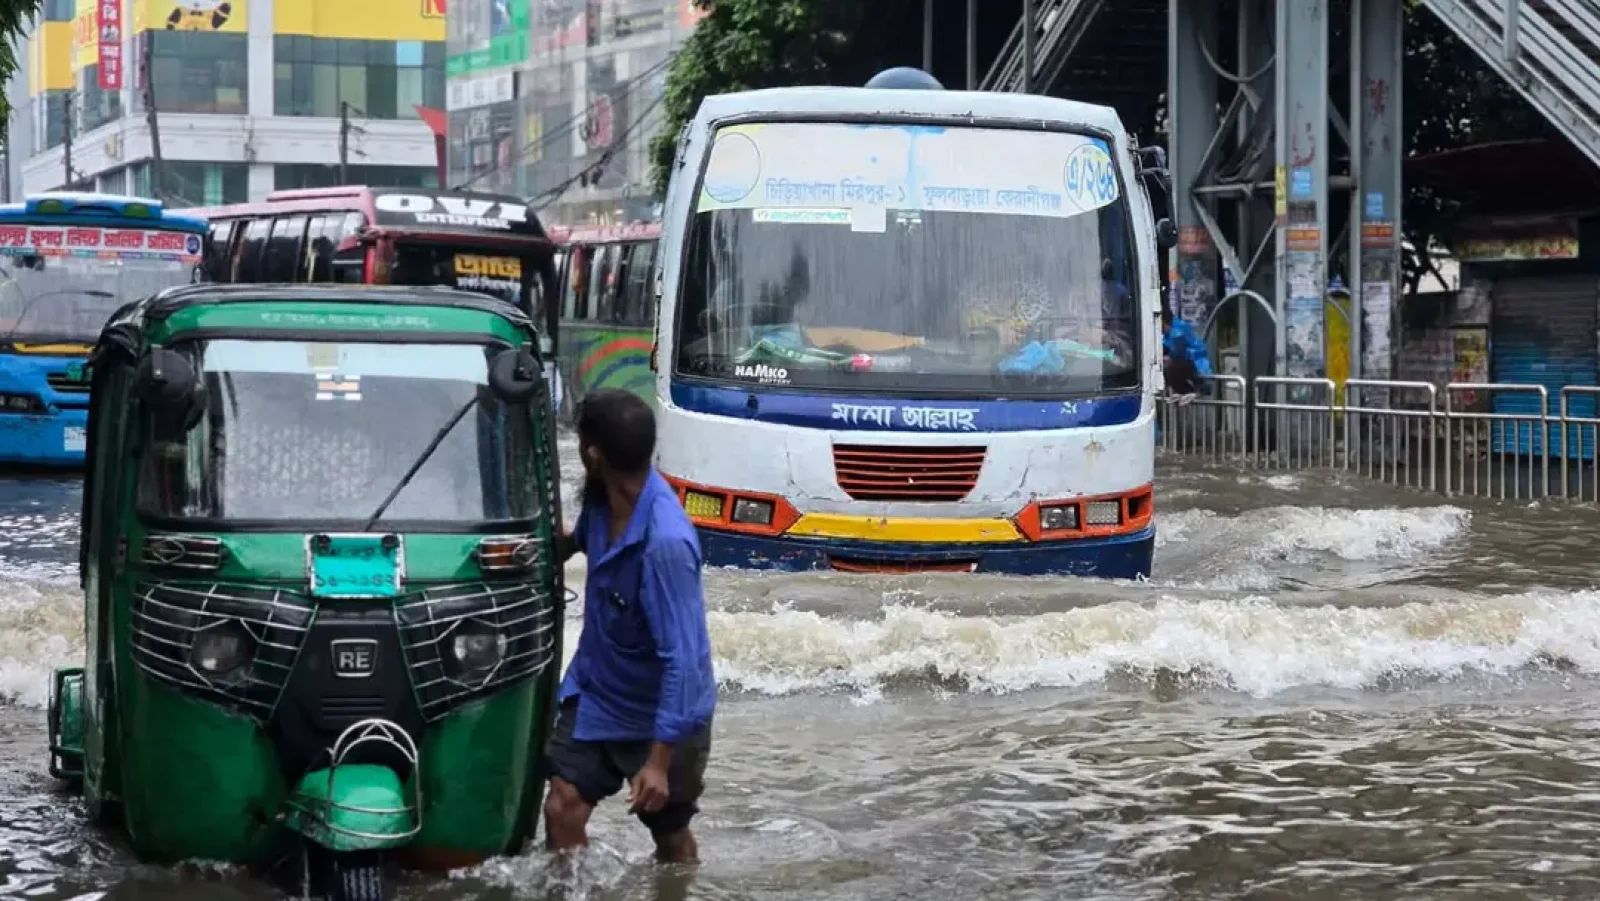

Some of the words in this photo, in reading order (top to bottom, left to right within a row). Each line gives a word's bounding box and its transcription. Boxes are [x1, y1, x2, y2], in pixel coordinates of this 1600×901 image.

[376, 194, 527, 222] OVI
[415, 212, 511, 230] ENTERPRISE
[735, 364, 788, 379] HAMKO
[831, 403, 897, 428] মাশা
[339, 651, 370, 669] RE
